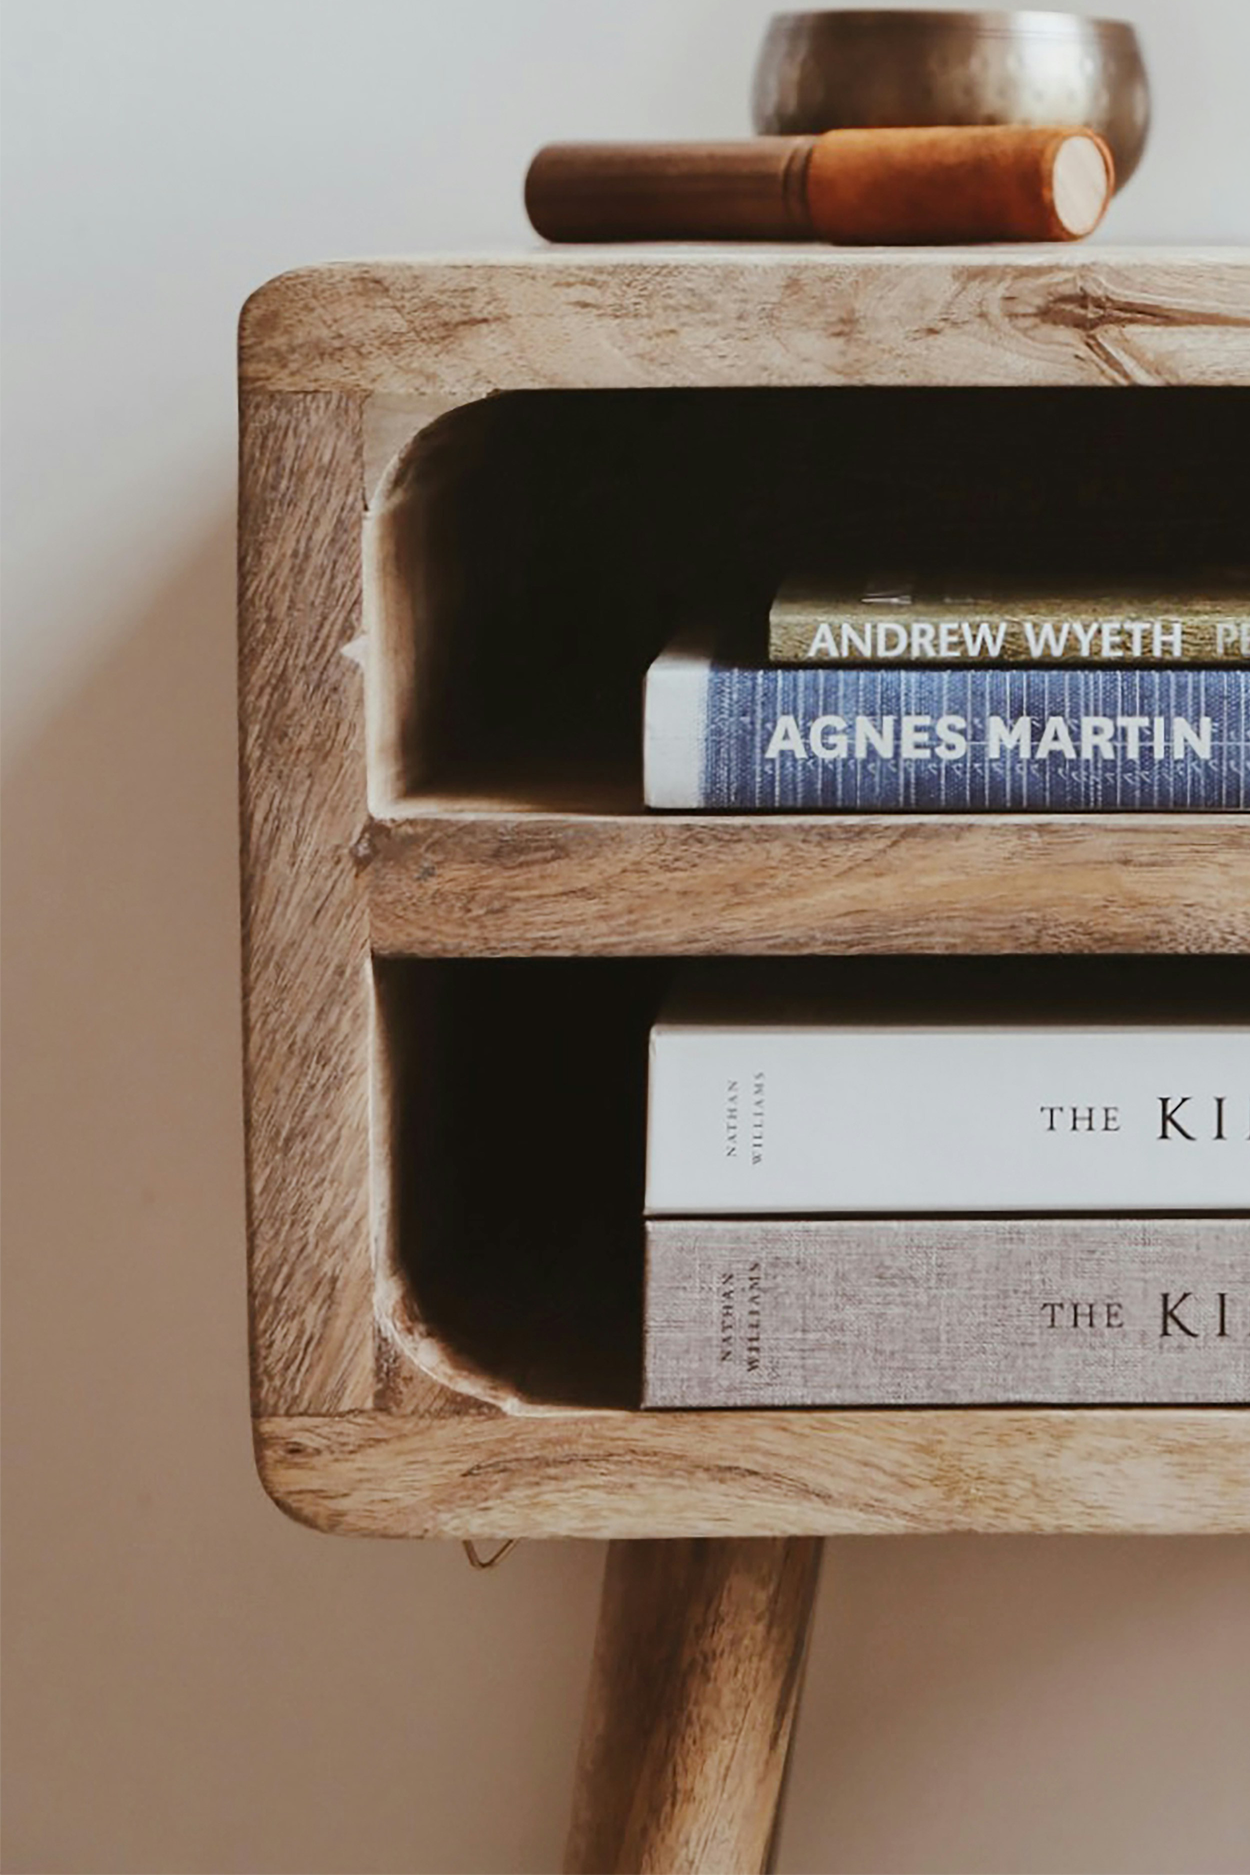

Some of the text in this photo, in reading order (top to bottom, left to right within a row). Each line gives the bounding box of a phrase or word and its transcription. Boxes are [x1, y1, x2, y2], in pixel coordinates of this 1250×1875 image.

[807, 623, 1006, 658] ANDREW
[1023, 623, 1183, 658] WYETH
[765, 713, 1213, 760] AGNES MARTIN
[726, 1079, 739, 1158] NATHAN
[751, 1071, 766, 1166] WILLIAMS
[1040, 1104, 1121, 1133] THE
[720, 1272, 734, 1362] NATHAN
[746, 1262, 761, 1373] WILLIAMS
[1041, 1301, 1126, 1329] THE
